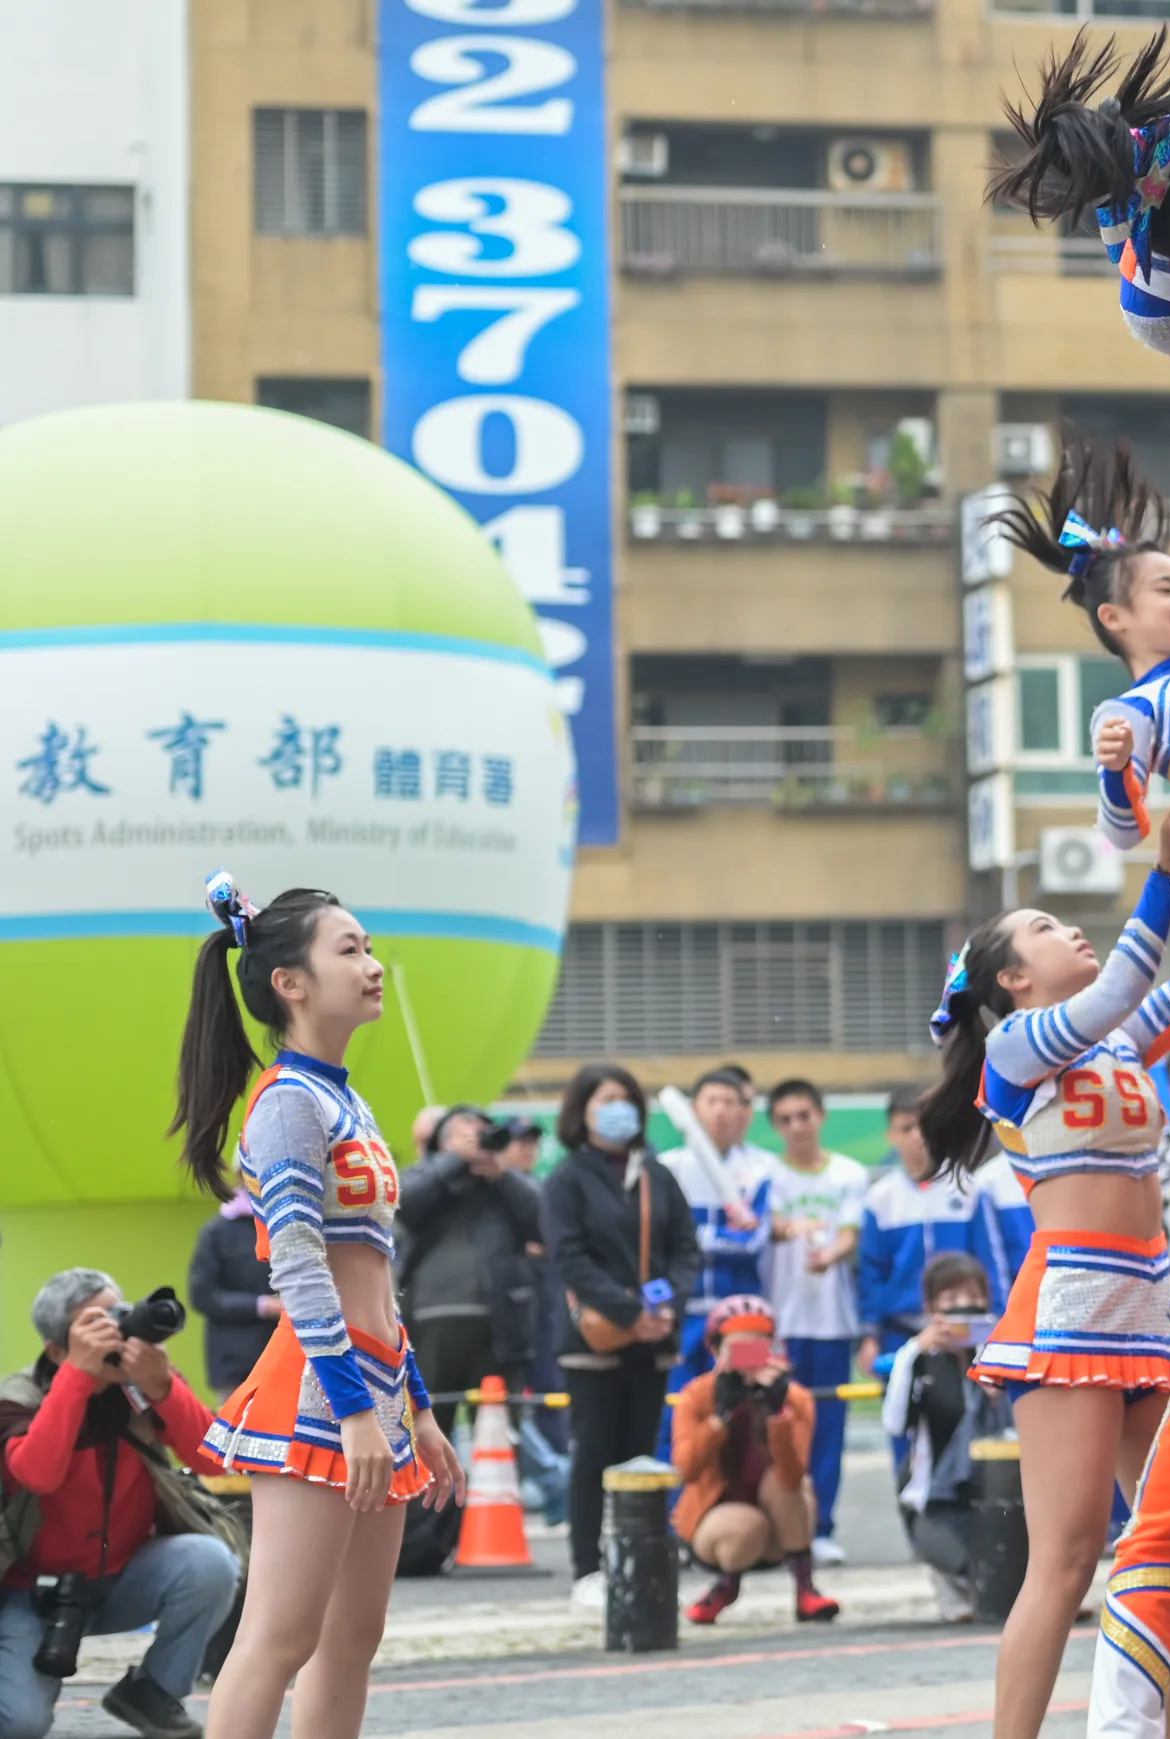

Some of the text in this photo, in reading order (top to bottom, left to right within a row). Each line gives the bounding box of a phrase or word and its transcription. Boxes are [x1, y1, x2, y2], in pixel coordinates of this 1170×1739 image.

[405, 0, 592, 716] 2 3704
[17, 712, 514, 806] 教育部 體育署
[307, 819, 400, 853] Ministry
